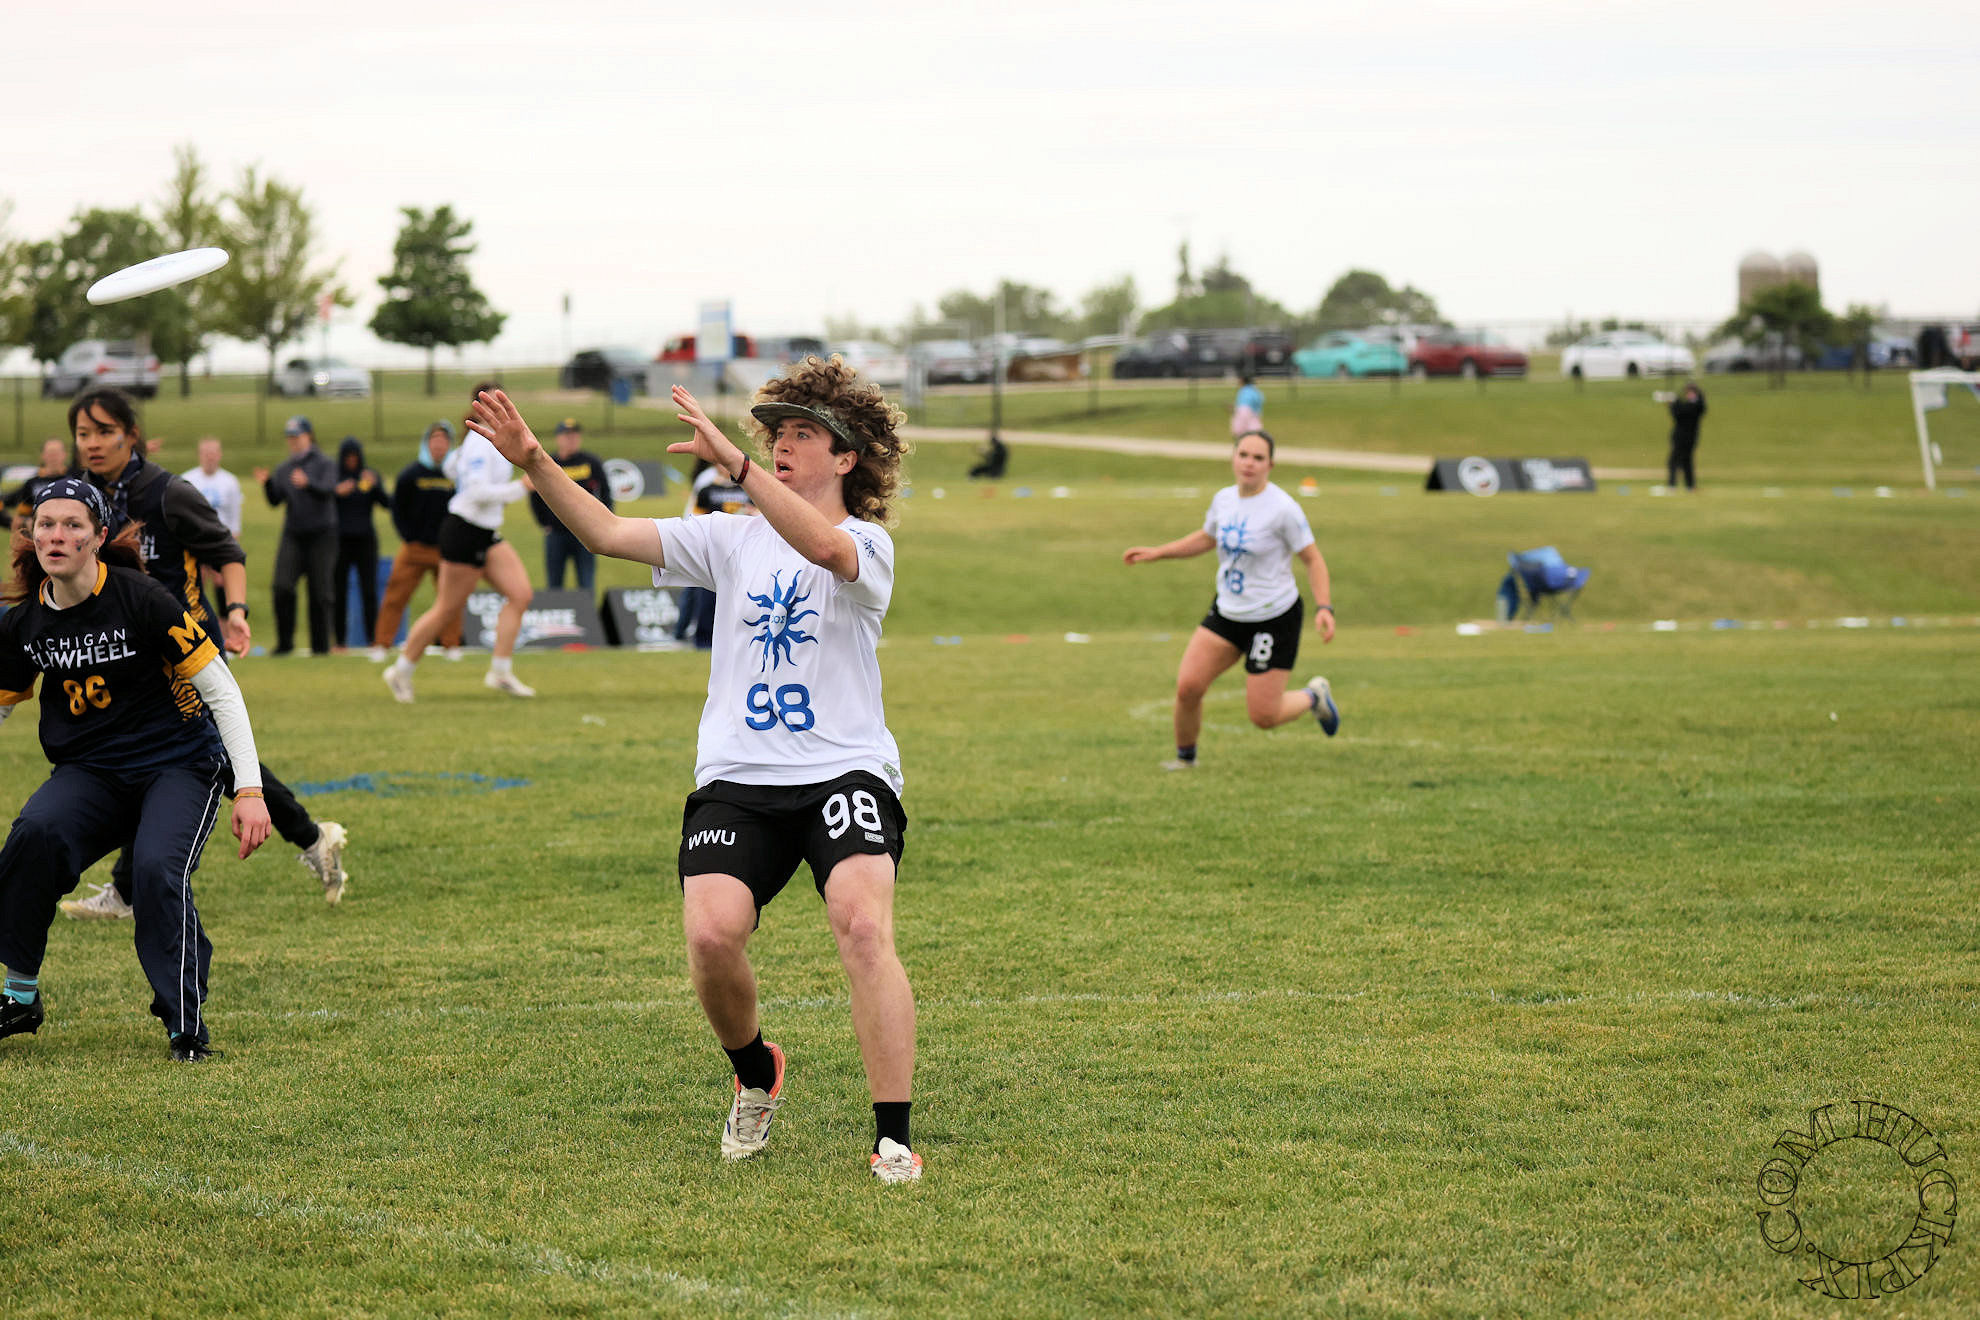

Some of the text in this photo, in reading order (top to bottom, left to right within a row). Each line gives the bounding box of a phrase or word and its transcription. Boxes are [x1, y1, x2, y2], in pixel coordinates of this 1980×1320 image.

[23, 627, 127, 655] MICHIGAN
[168, 610, 207, 655] M
[63, 675, 112, 716] 86
[744, 682, 816, 733] 98
[821, 789, 882, 840] 98
[688, 829, 737, 851] WWU
